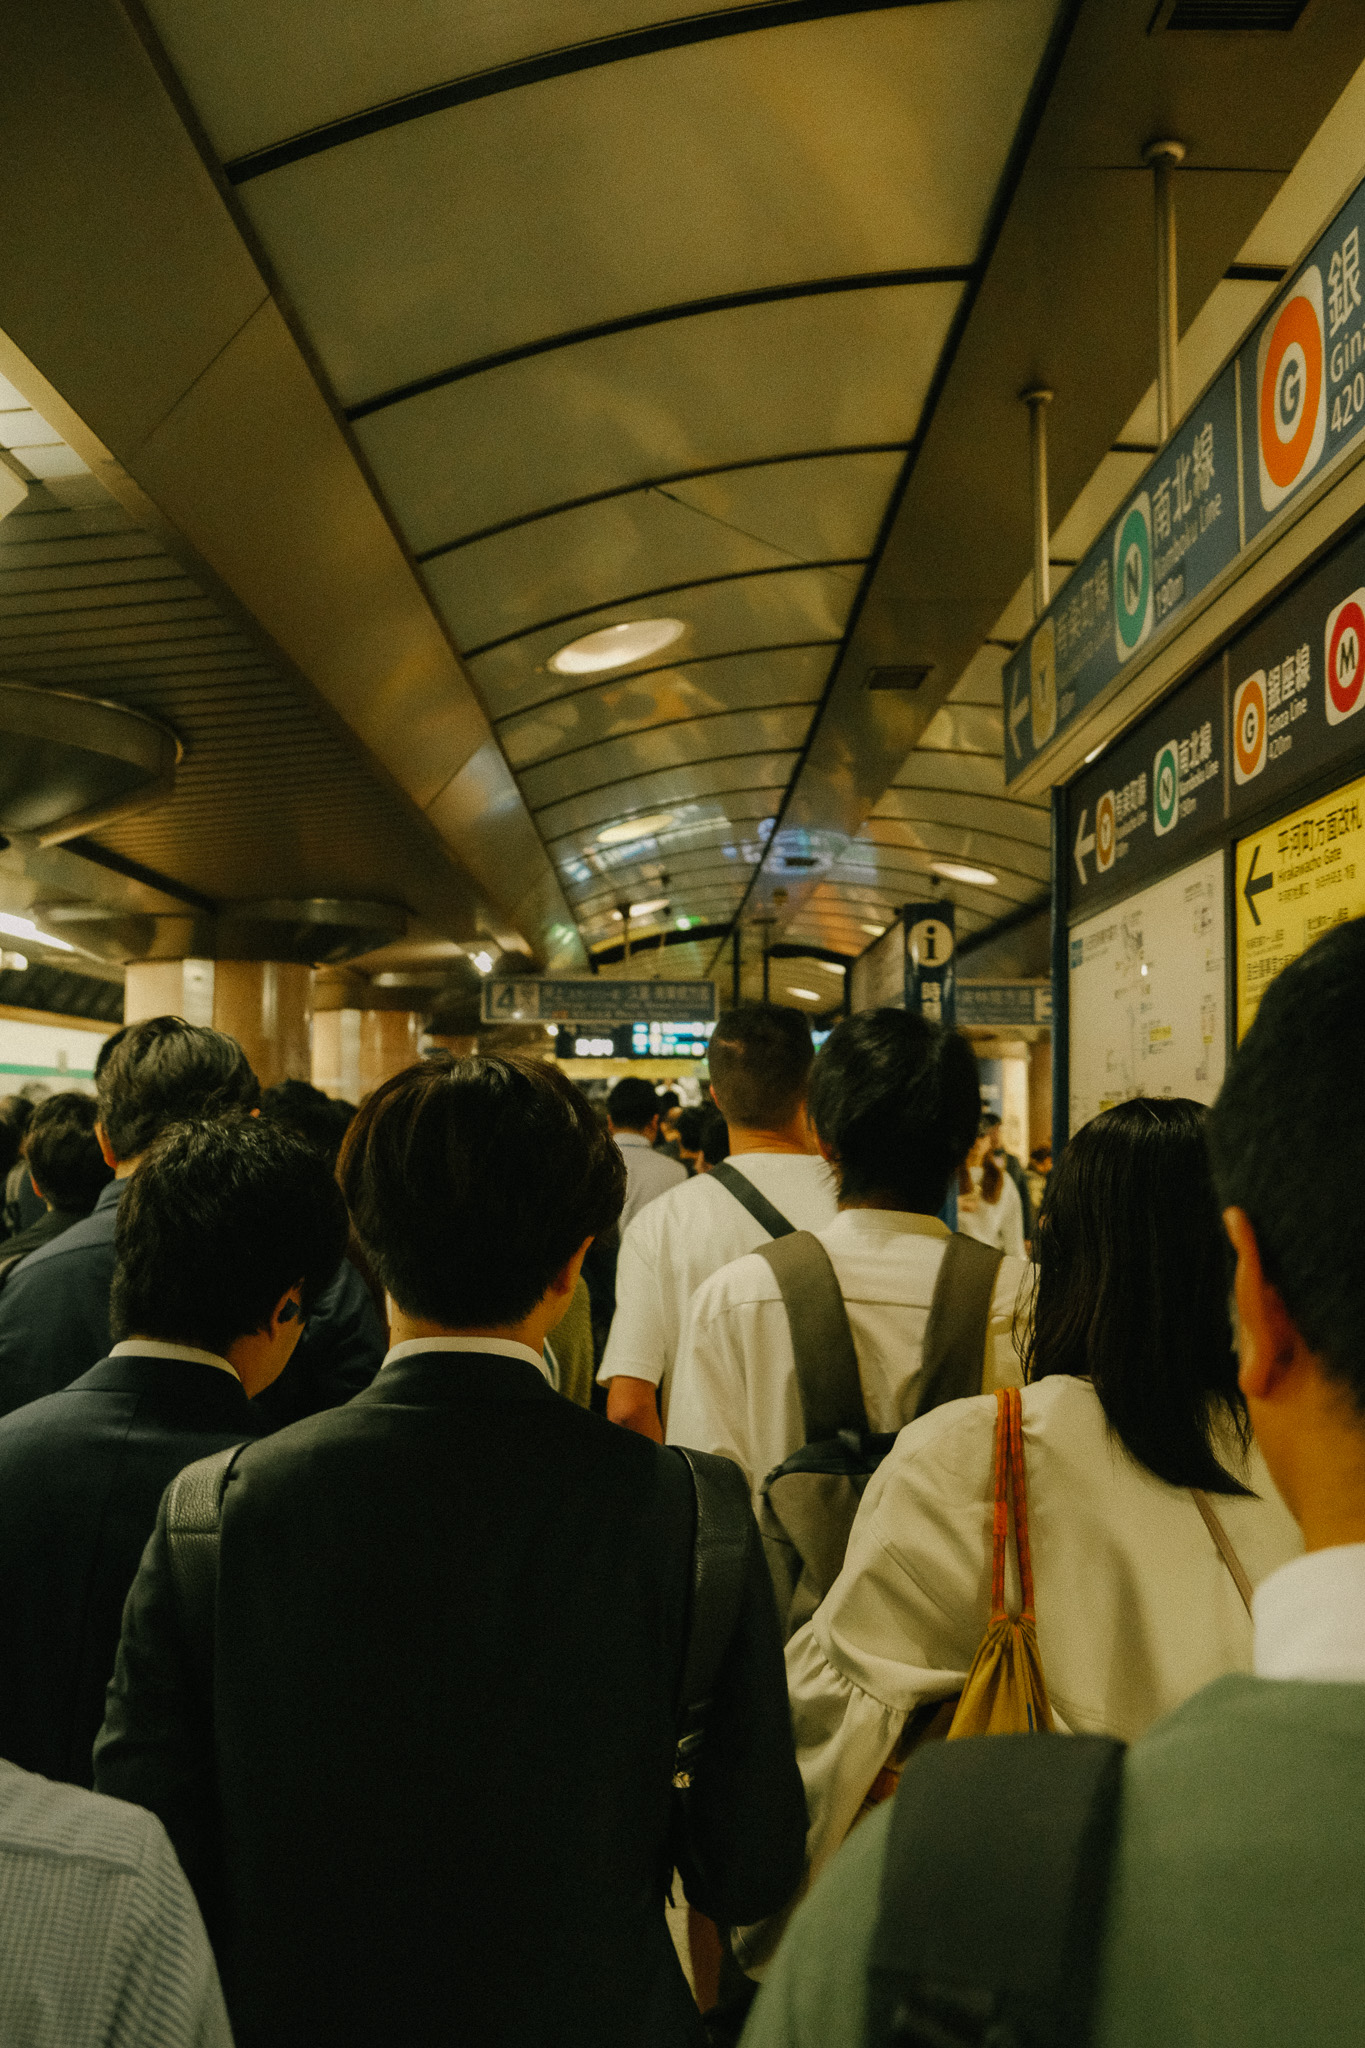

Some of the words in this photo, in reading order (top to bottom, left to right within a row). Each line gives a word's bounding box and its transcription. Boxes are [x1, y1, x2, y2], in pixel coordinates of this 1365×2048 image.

[1328, 225, 1361, 338] 銀
[1280, 358, 1300, 426] G
[1152, 421, 1215, 549] 南北線
[1126, 552, 1139, 607] N
[1267, 642, 1310, 712] 銀座線
[1339, 635, 1356, 679] M
[1245, 712, 1256, 744] G
